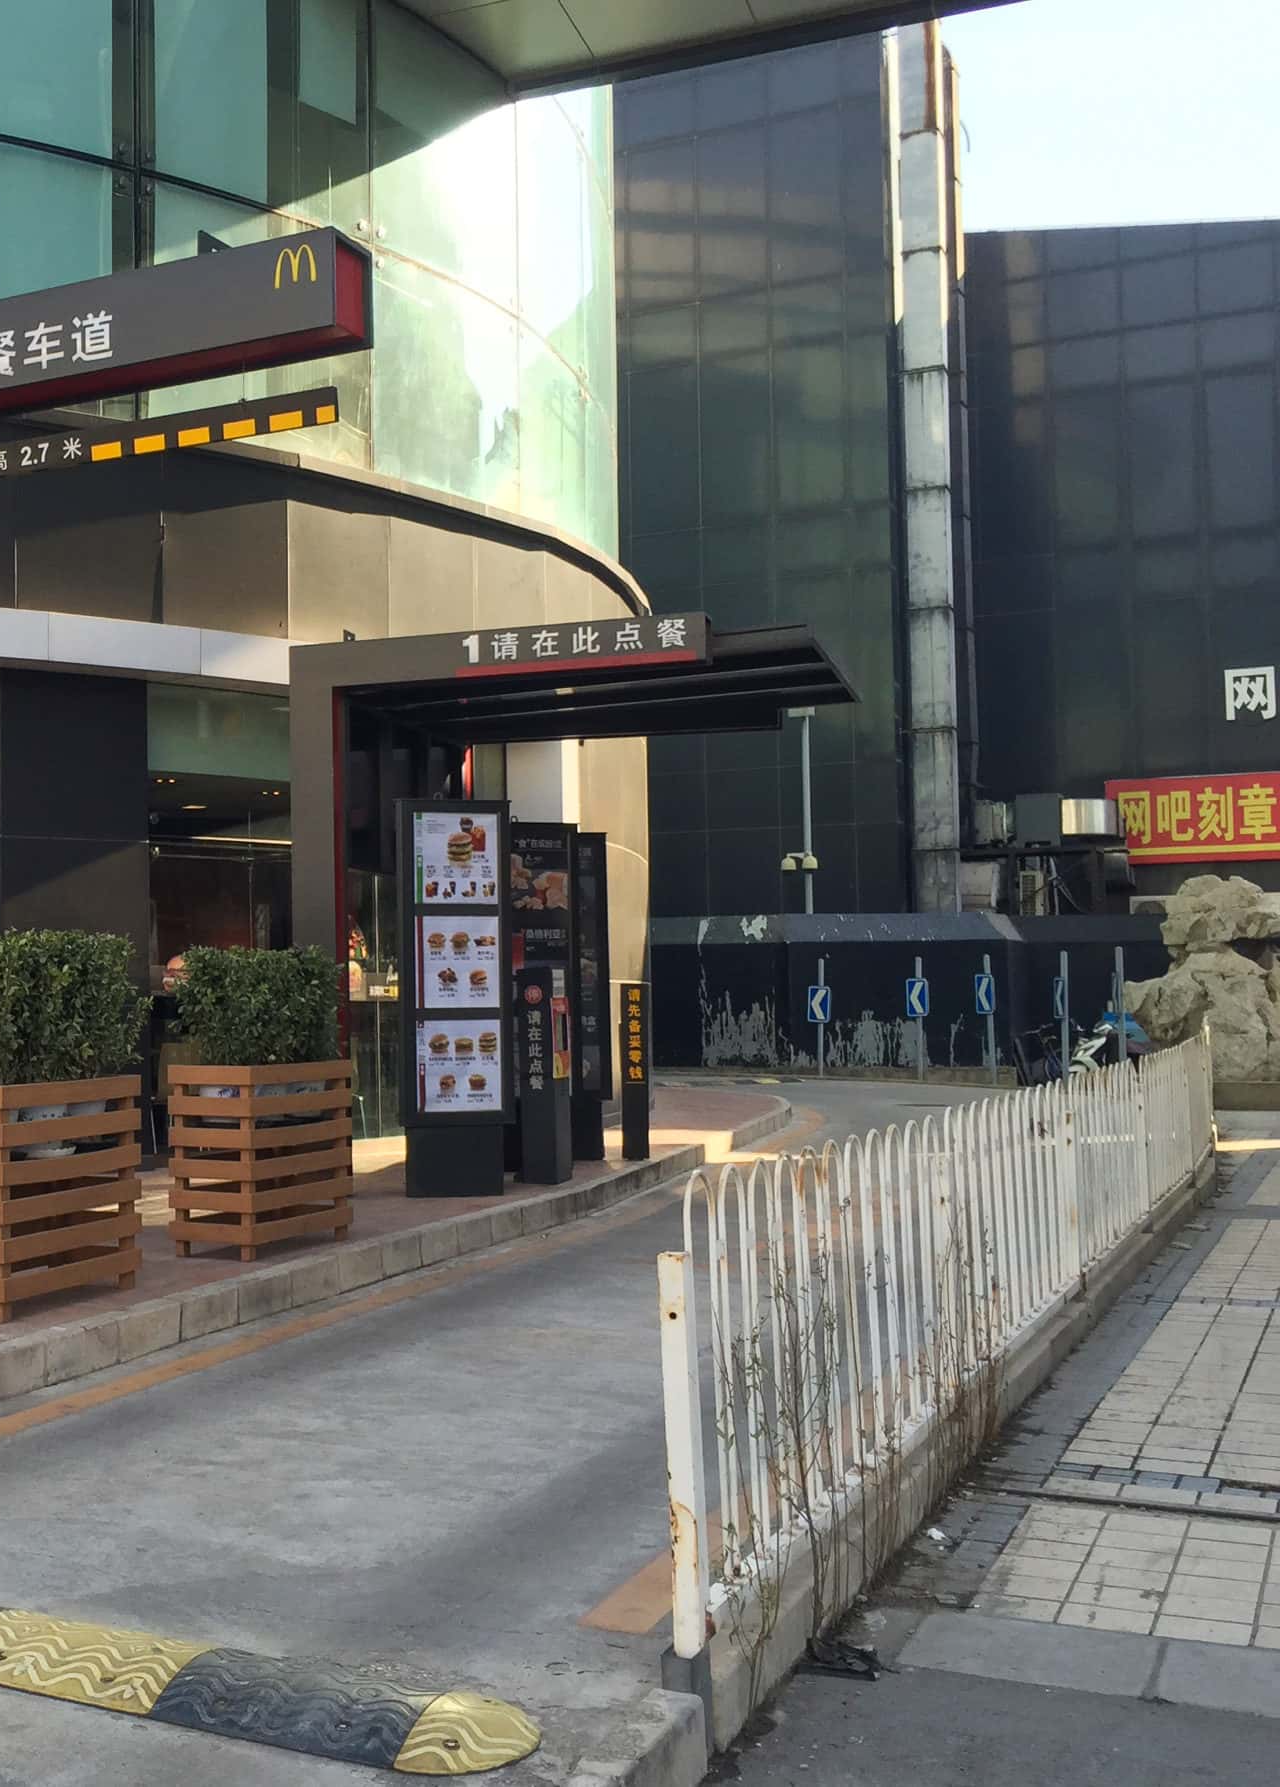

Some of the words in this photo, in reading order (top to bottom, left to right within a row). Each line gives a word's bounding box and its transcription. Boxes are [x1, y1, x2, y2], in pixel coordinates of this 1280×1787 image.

[1224, 665, 1277, 721] 网
[1118, 783, 1277, 845] 网吧刻章
[527, 1010, 544, 1090] 请在此点餐
